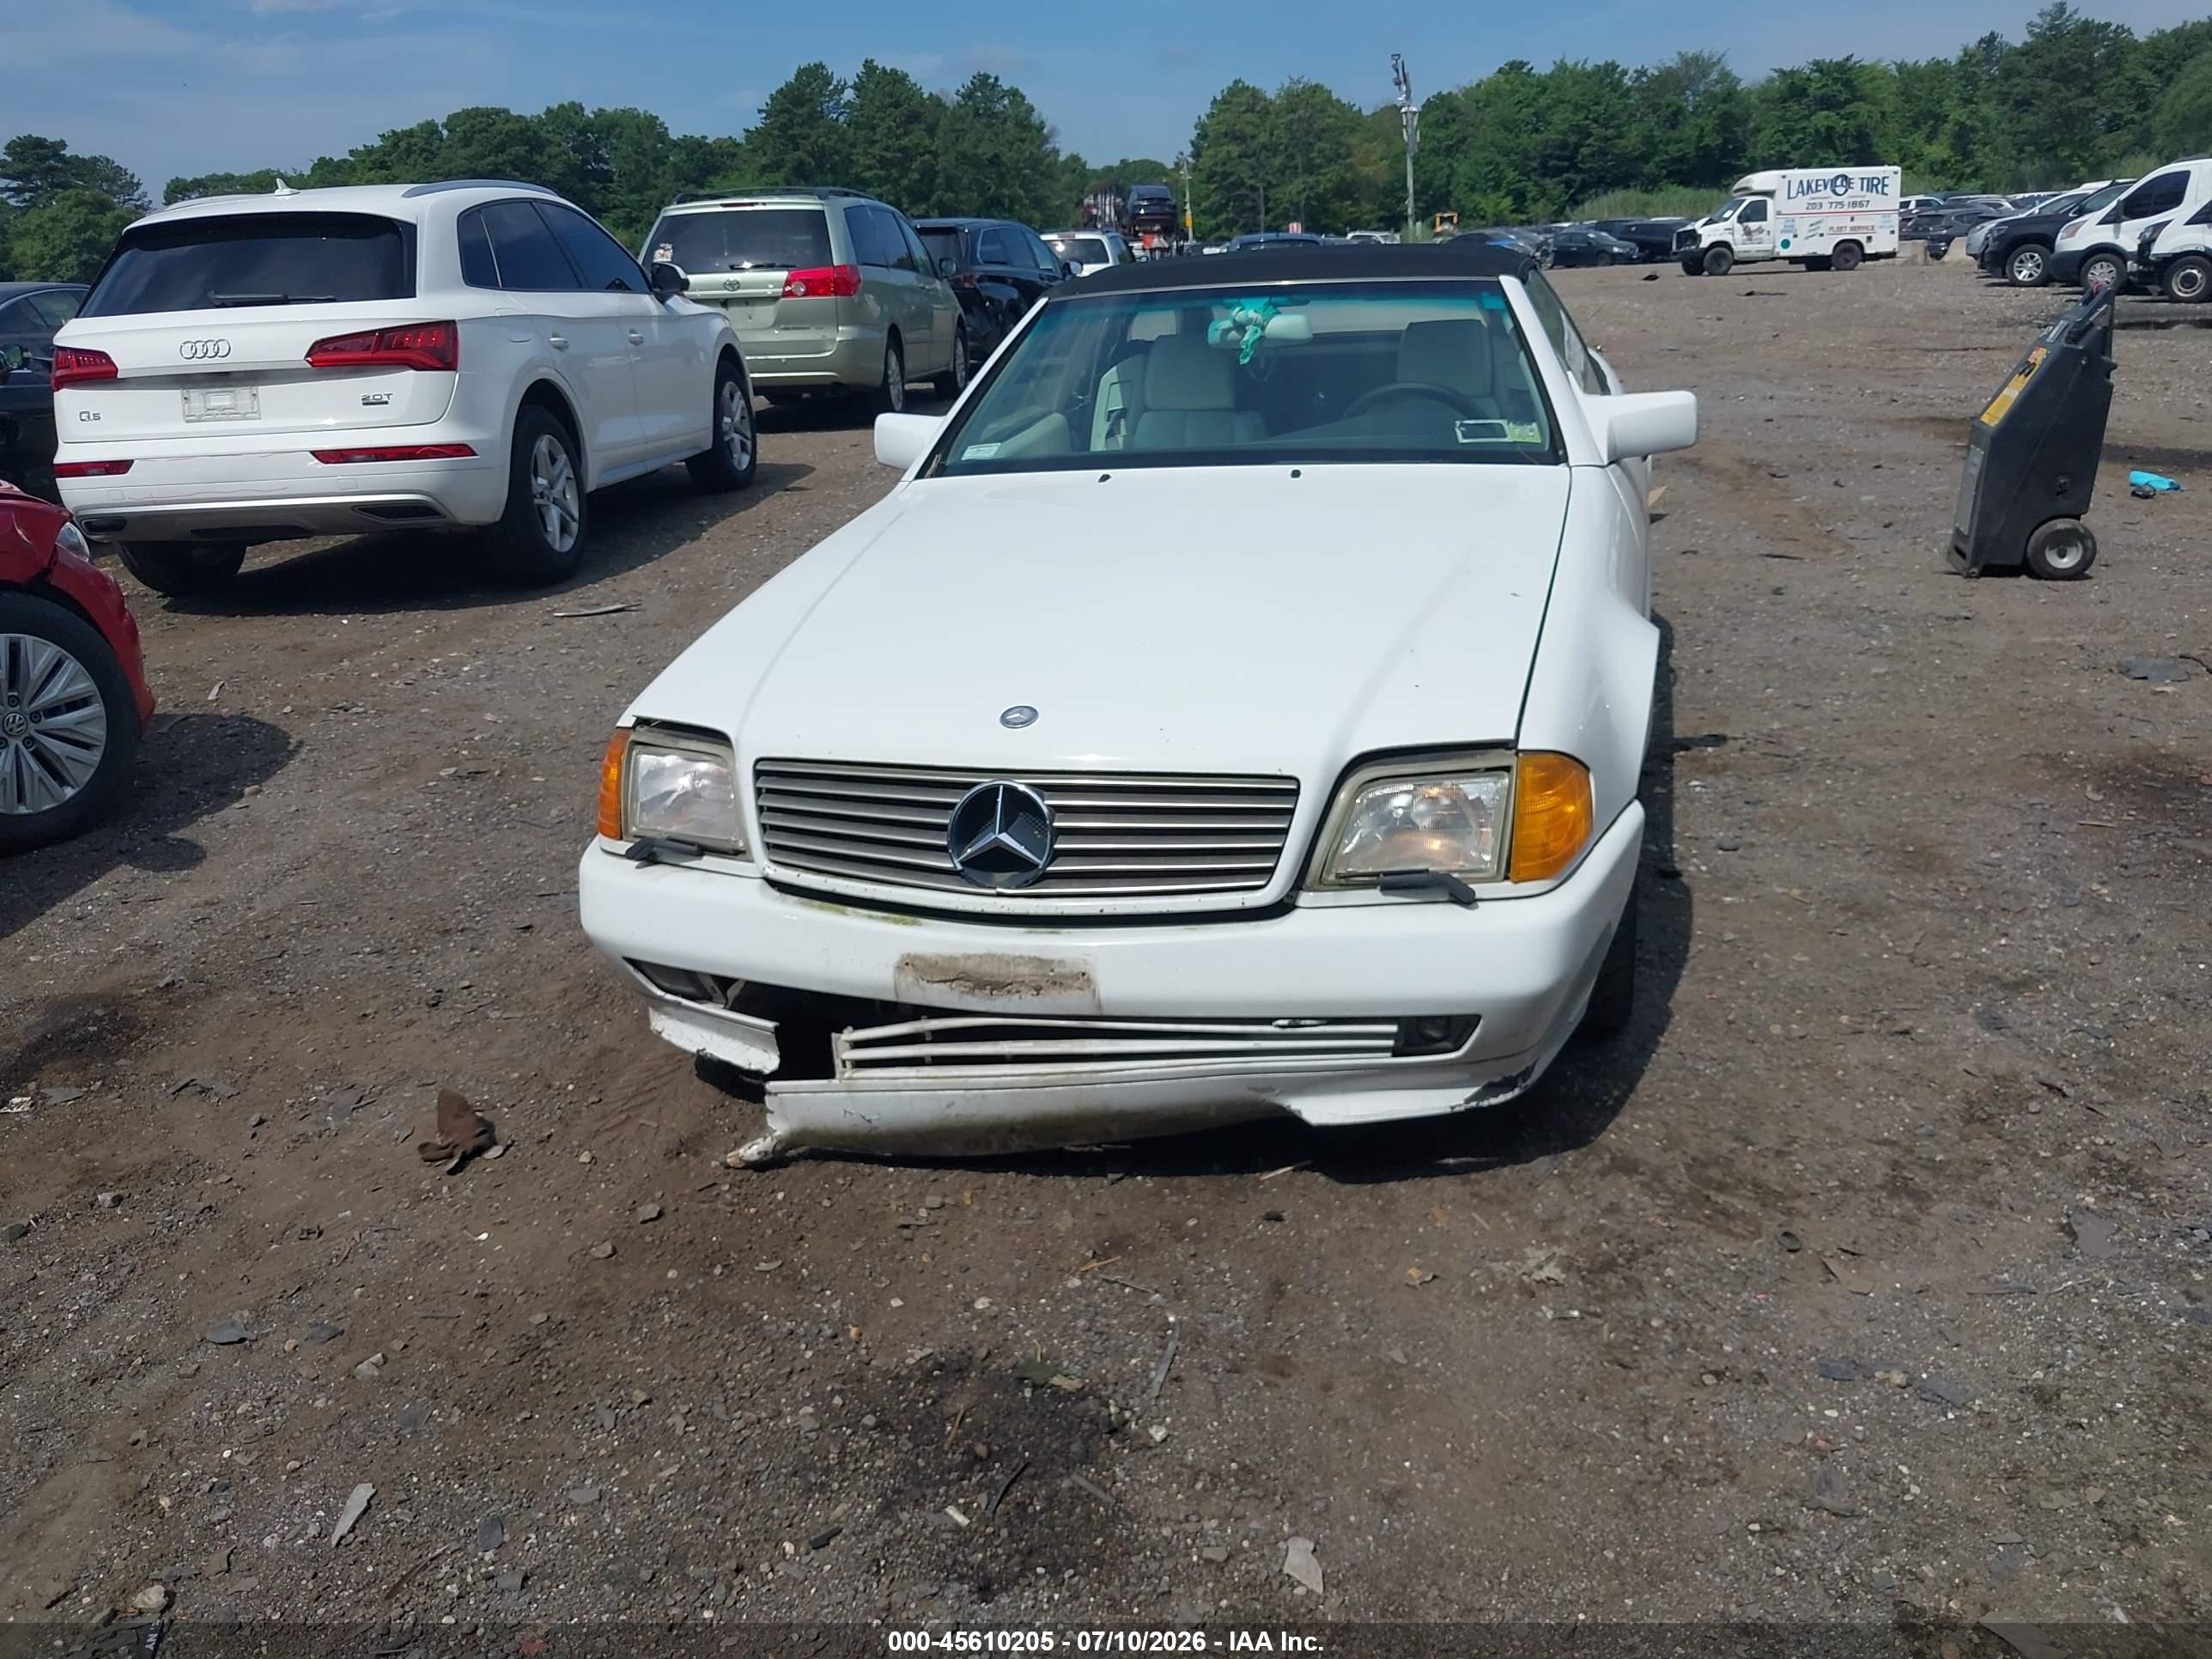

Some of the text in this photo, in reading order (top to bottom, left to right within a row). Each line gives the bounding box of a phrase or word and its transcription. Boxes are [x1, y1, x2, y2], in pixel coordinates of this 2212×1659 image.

[1858, 176, 1889, 196] TIRE
[1806, 201, 1823, 210] 203
[1827, 201, 1844, 210] 775
